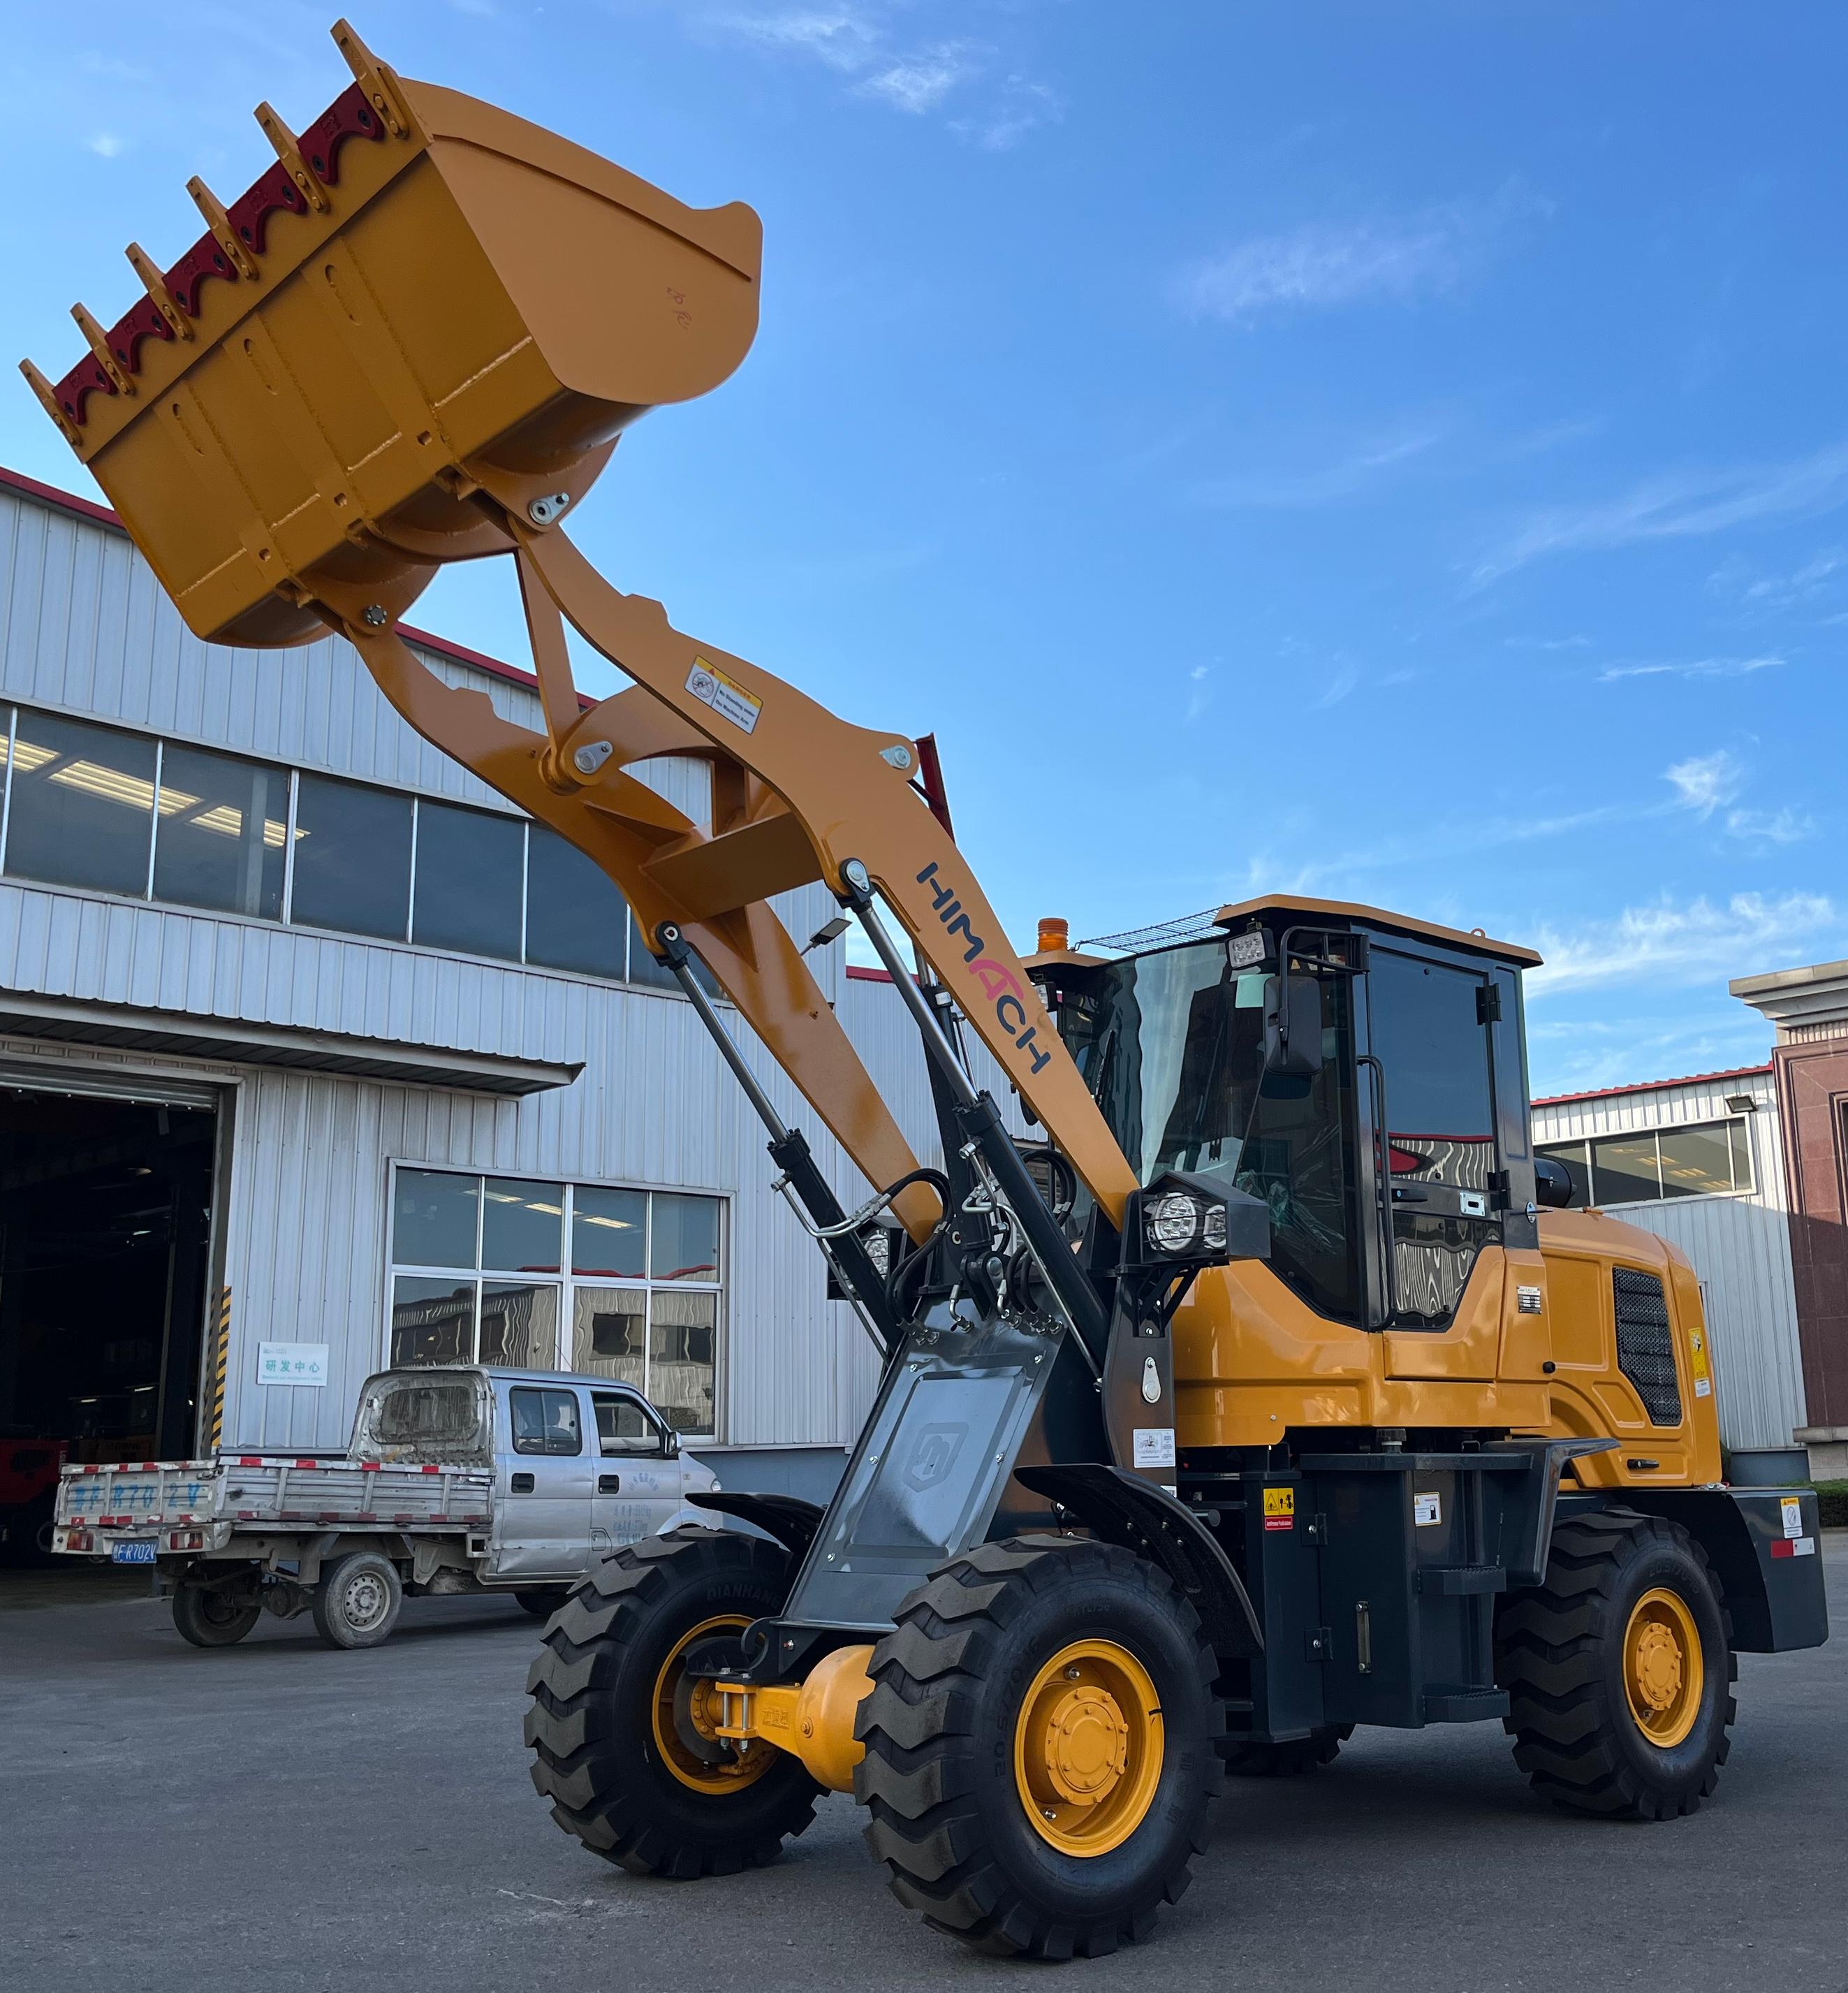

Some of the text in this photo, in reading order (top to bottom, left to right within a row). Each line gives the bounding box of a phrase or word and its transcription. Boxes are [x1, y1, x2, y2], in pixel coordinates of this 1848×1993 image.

[727, 680, 751, 701] DANGER
[916, 861, 1051, 1074] HIMACH
[265, 1359, 320, 1373] 研发中心
